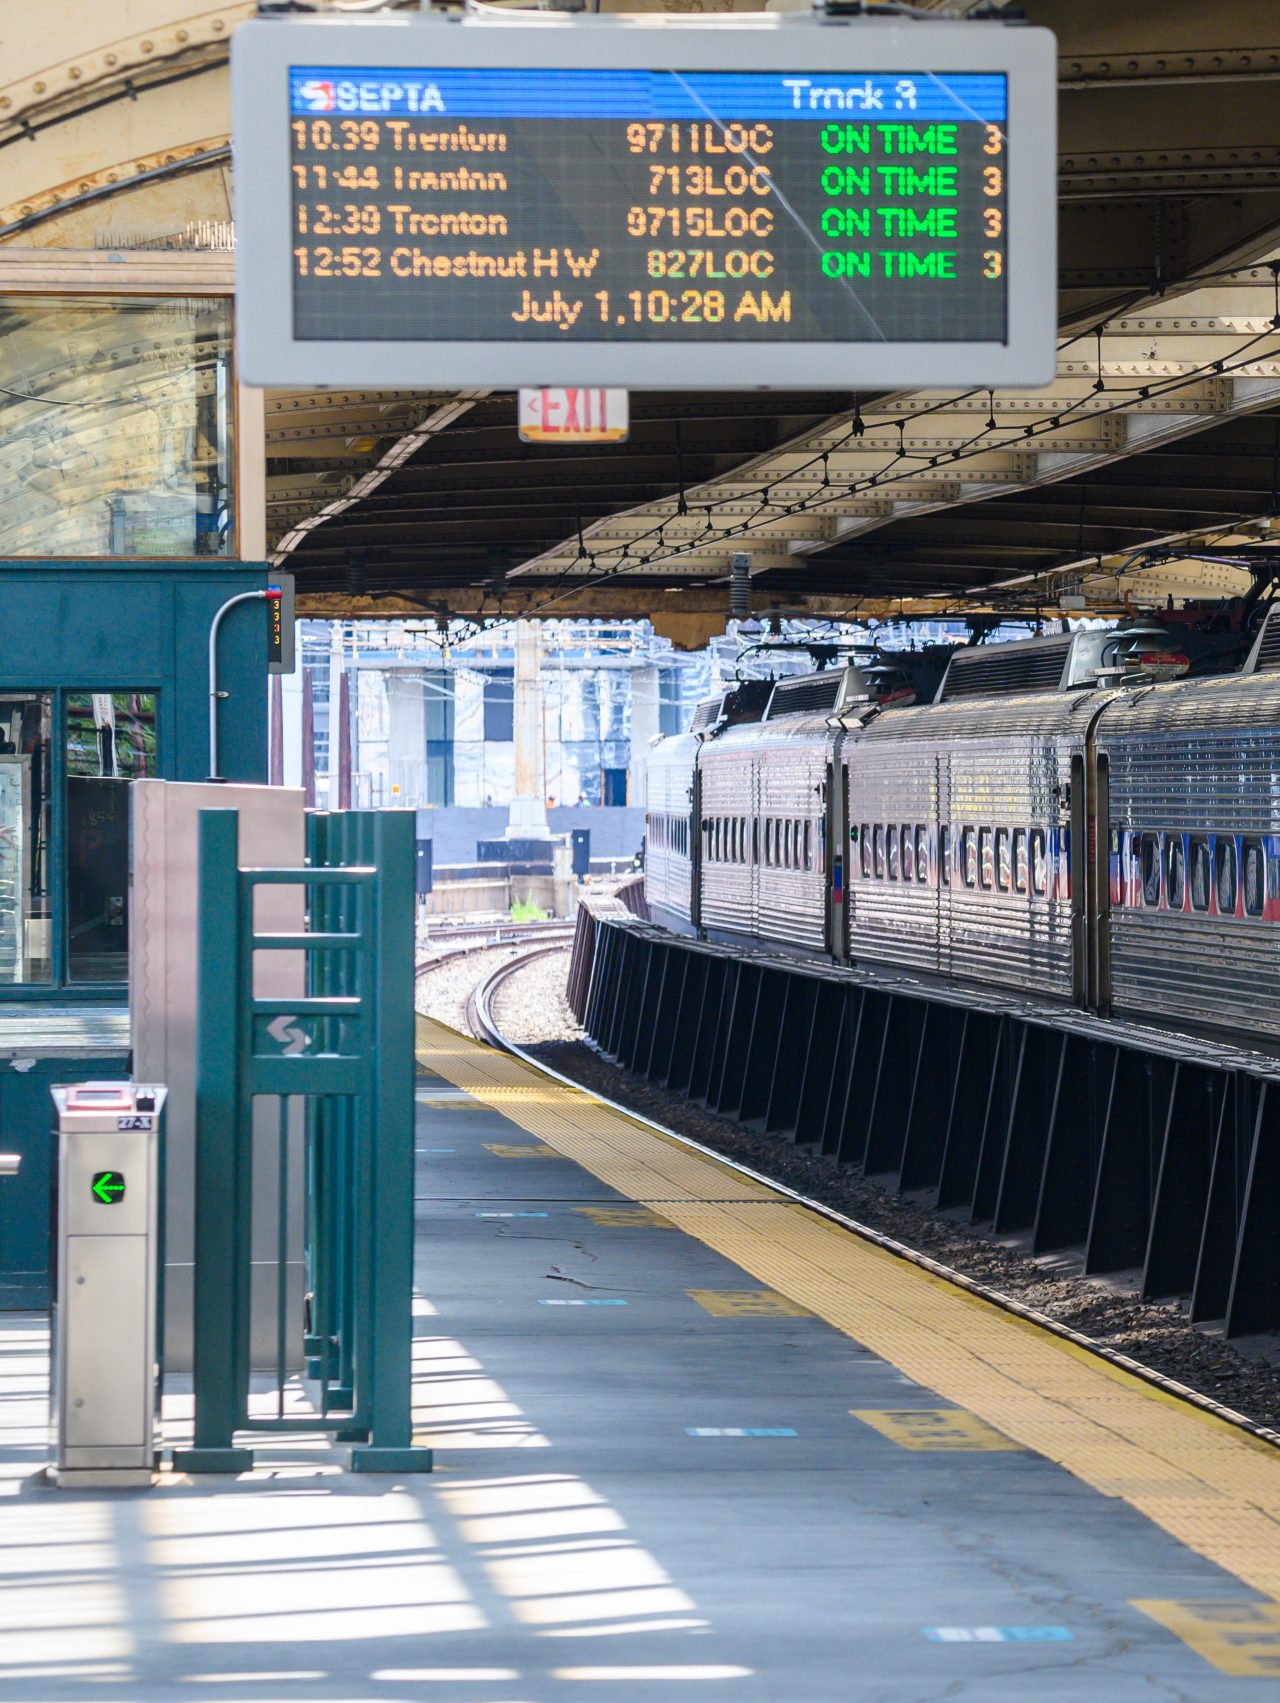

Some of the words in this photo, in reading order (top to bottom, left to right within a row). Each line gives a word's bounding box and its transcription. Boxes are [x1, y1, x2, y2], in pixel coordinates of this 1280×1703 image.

[336, 81, 447, 112] SEPTA
[820, 124, 870, 154] ON
[876, 124, 959, 155] TIME
[983, 124, 1002, 155] 3
[820, 166, 870, 196] ON
[876, 166, 959, 197] TIME
[983, 166, 1002, 197] 3
[298, 204, 381, 235] 12:39
[821, 207, 871, 238] ON
[876, 207, 959, 238] TIME
[983, 207, 1002, 238] 3
[294, 247, 382, 277] 12:52
[390, 247, 528, 277] Chestnut
[532, 248, 559, 277] H
[564, 248, 600, 278] W
[821, 251, 871, 279] ON
[878, 251, 958, 279] TIME
[983, 250, 1002, 279] 3
[511, 290, 583, 330] July
[734, 290, 791, 322] AM
[118, 1116, 152, 1129] 27-X
